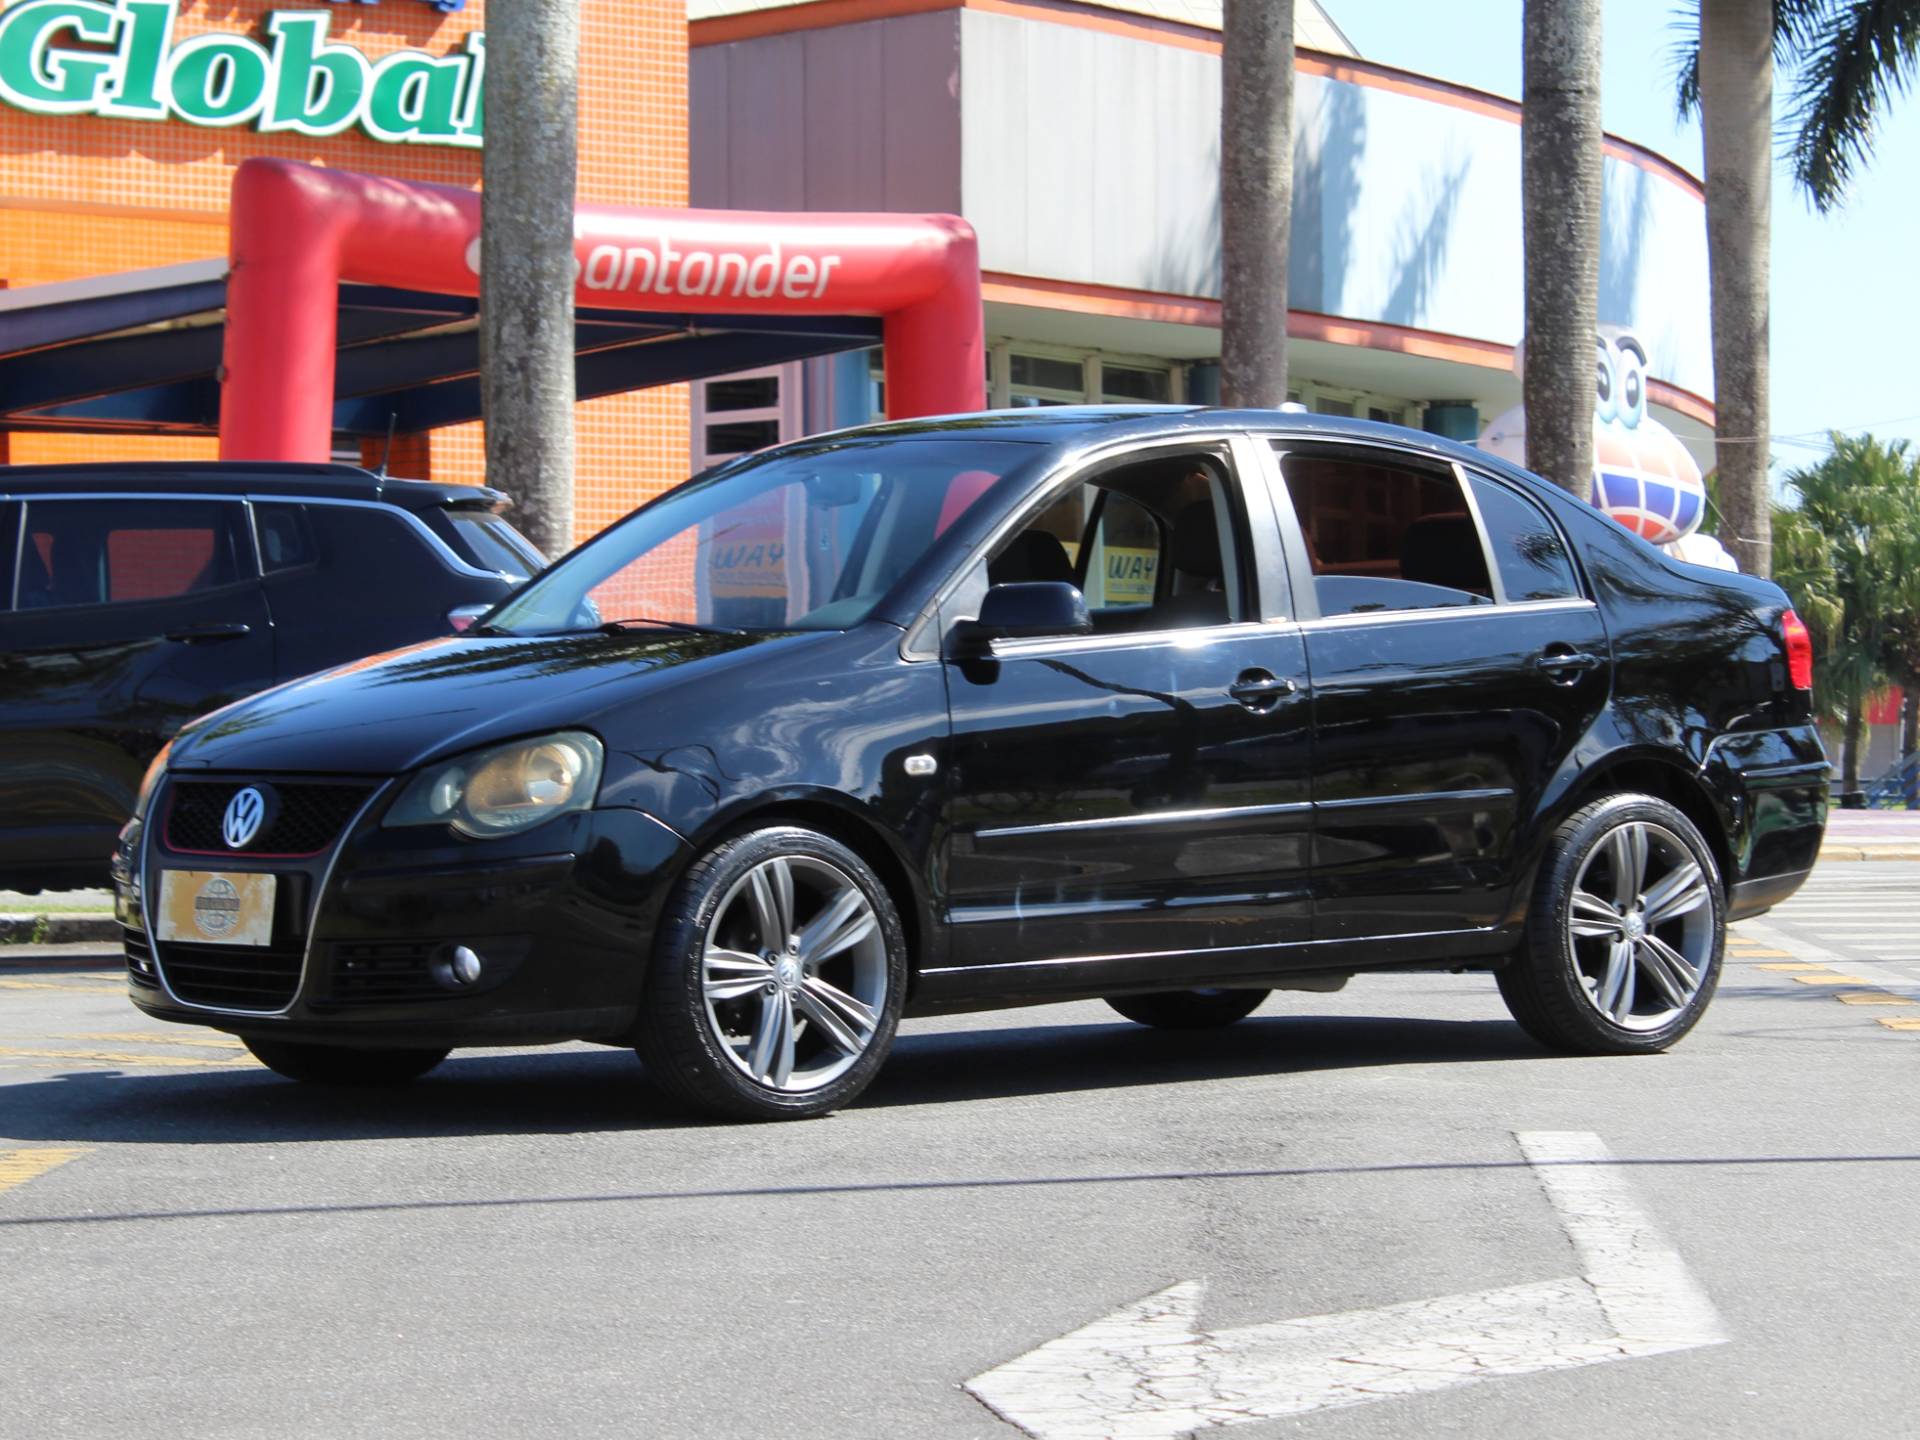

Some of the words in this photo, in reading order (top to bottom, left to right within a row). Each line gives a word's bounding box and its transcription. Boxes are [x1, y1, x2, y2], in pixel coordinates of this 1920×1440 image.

[573, 226, 842, 299] antander
[709, 543, 785, 570] WAY
[1109, 554, 1156, 580] WAY
